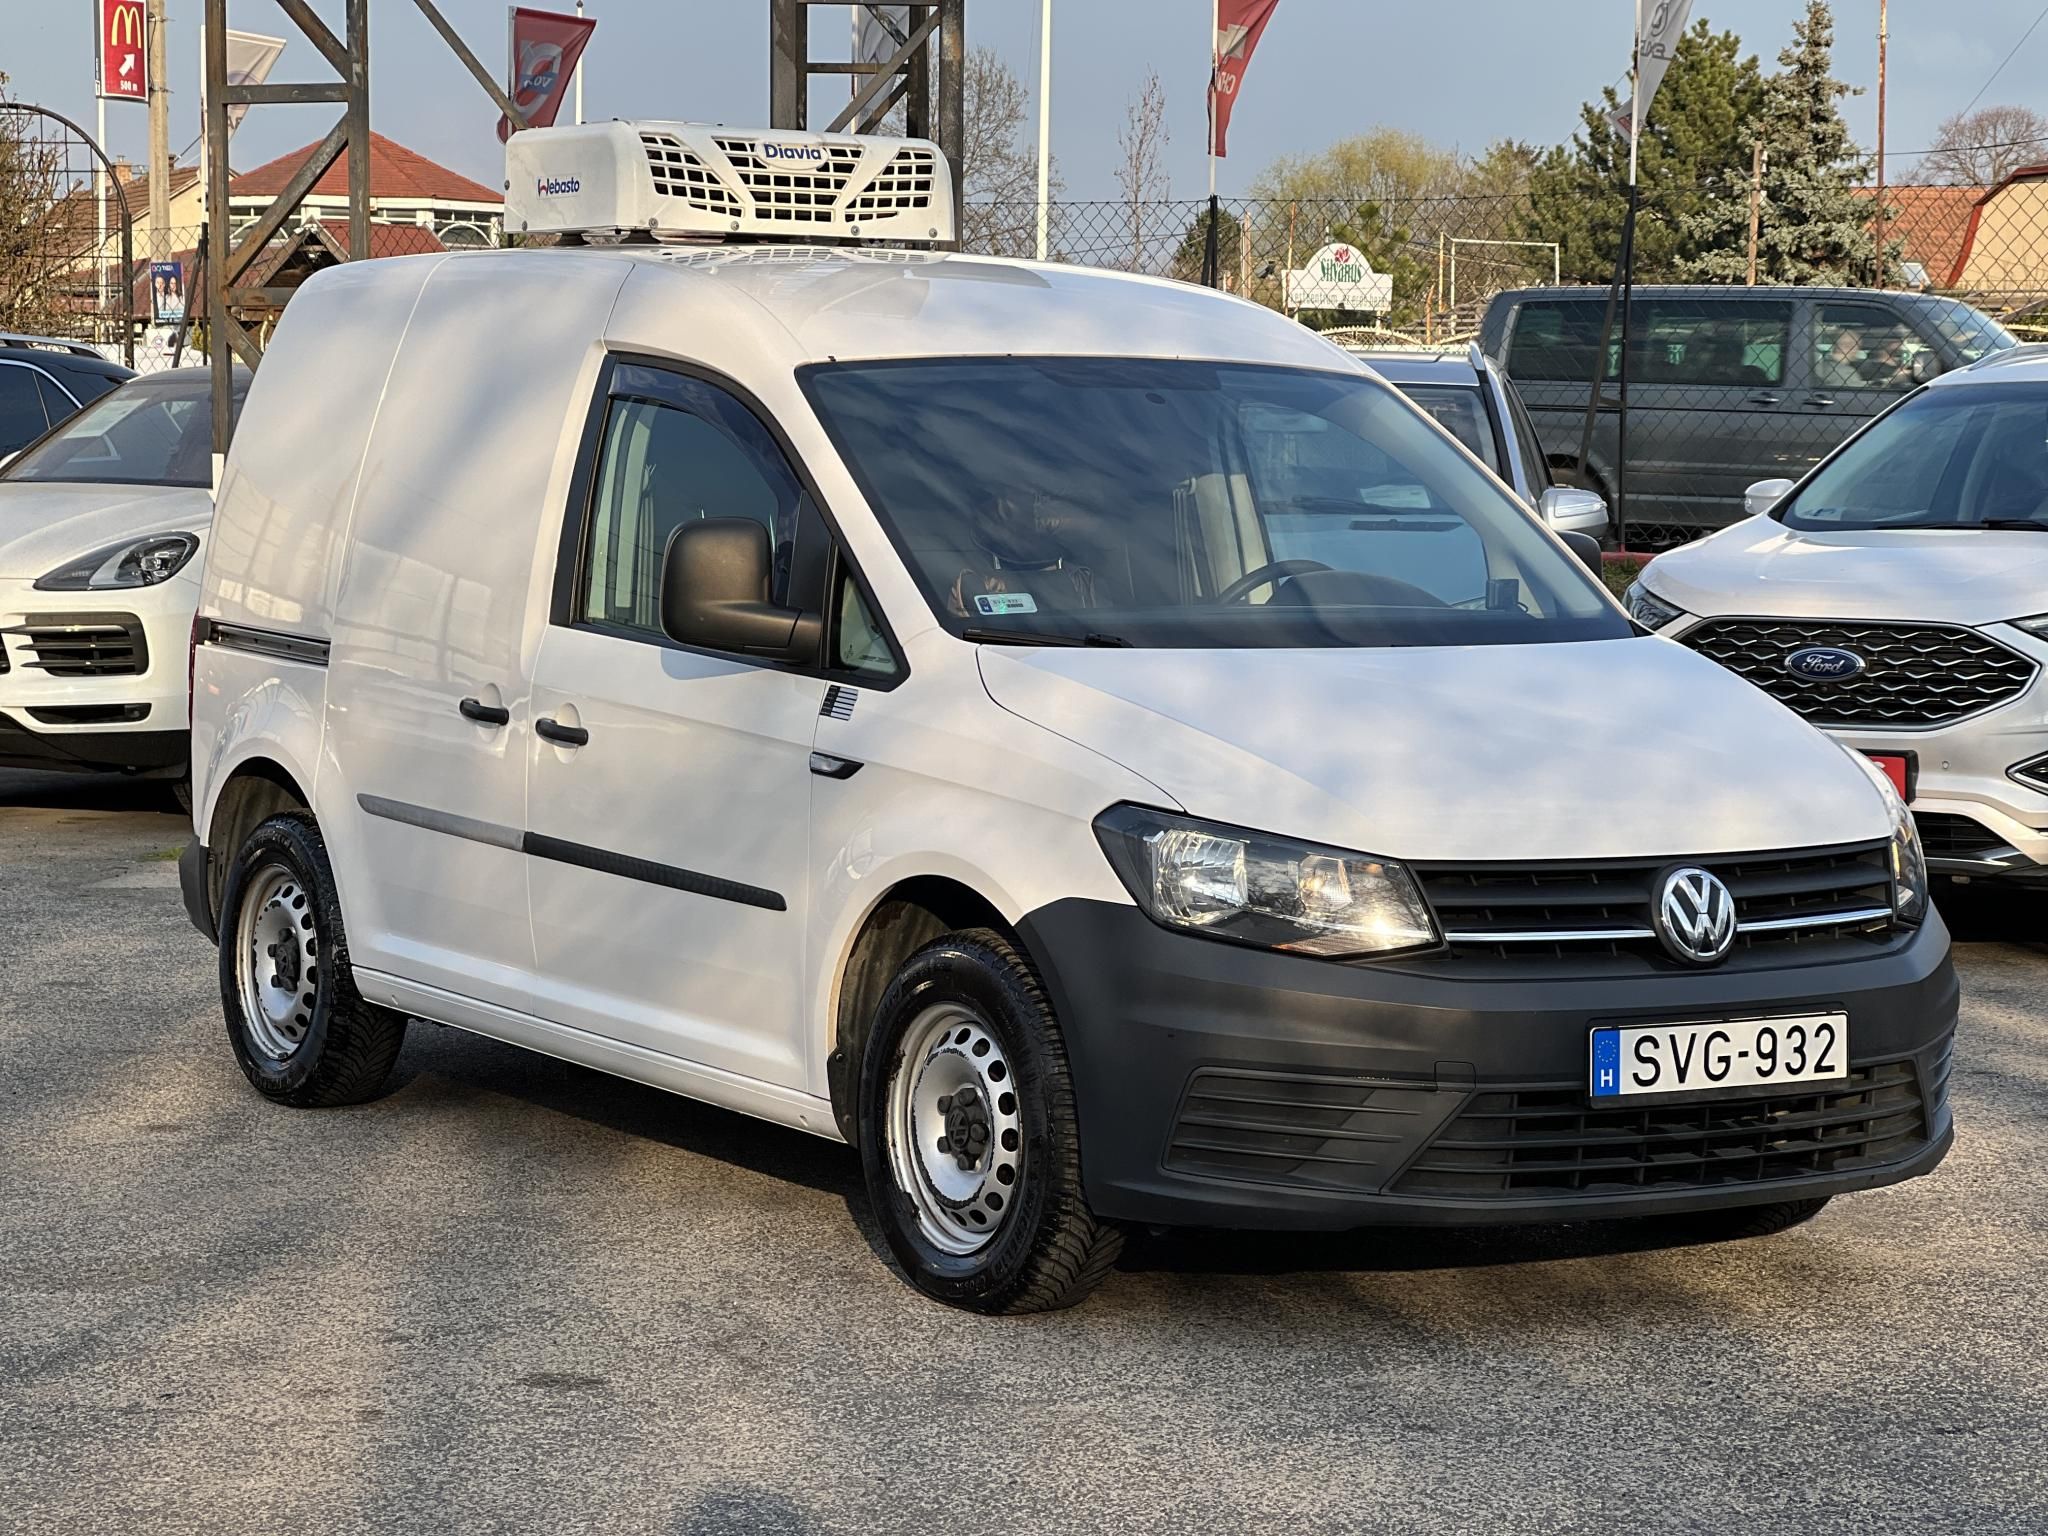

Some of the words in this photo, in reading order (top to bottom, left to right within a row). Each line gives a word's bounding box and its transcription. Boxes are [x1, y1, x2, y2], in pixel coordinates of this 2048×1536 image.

[120, 80, 131, 92] 500
[763, 143, 822, 160] Diavia
[537, 176, 580, 197] Webasto
[1802, 653, 1845, 673] Ford
[1600, 1068, 1614, 1088] H
[1632, 1022, 1836, 1087] SVG-932
